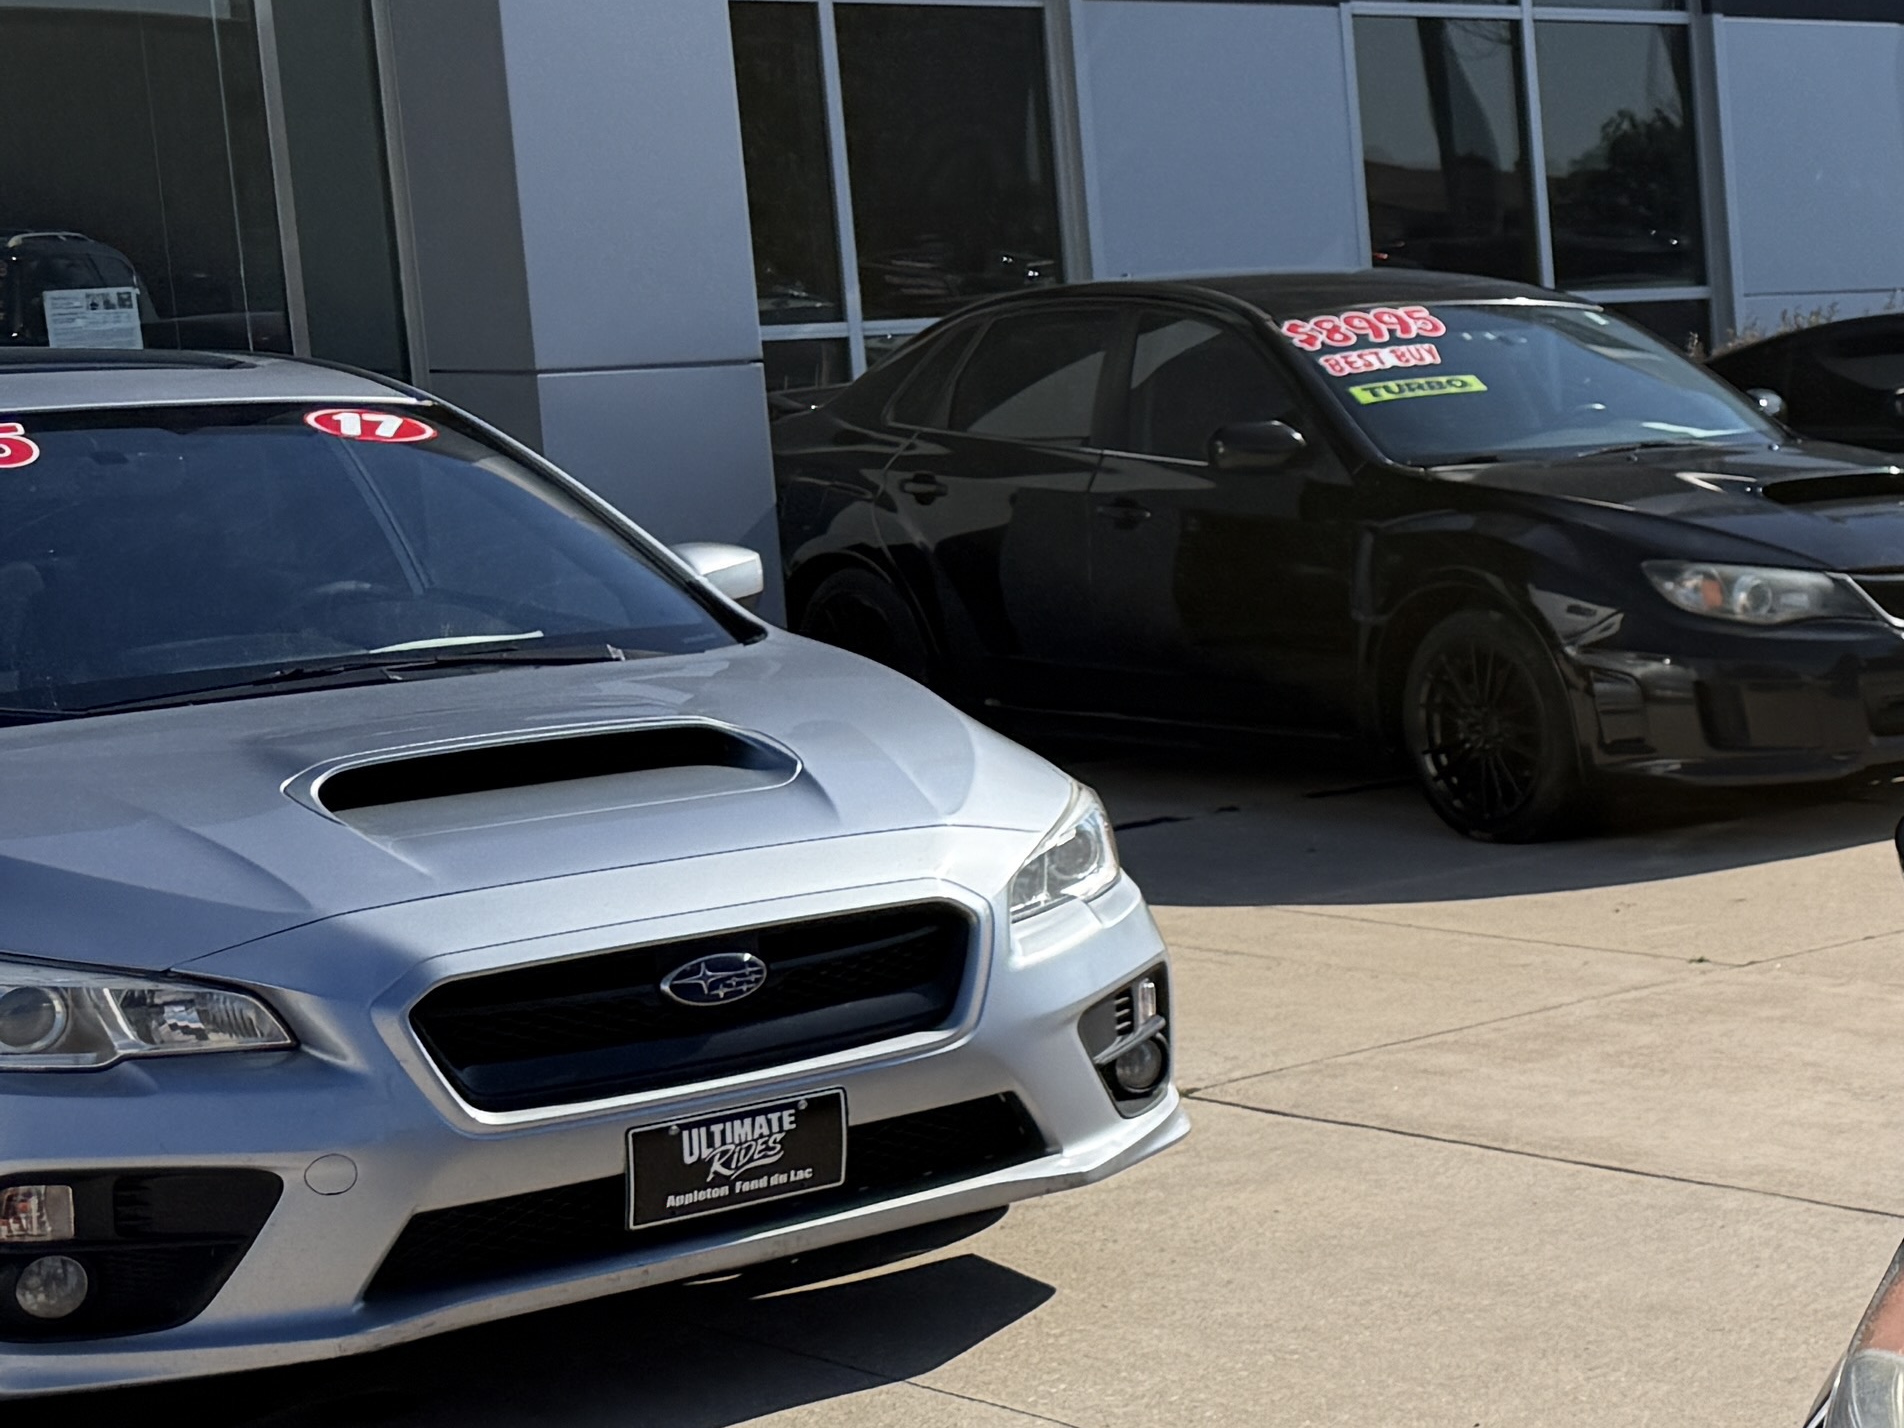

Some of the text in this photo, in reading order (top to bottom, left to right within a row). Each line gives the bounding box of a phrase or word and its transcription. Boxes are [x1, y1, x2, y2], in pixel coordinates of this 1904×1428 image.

[1282, 306, 1447, 352] $8995
[1321, 343, 1441, 376] BEST BUY
[1360, 378, 1470, 399] TURBO
[331, 412, 404, 438] 17
[682, 1109, 797, 1165] ULTIMATE
[666, 1167, 814, 1209] Appleton Fond du Lac
